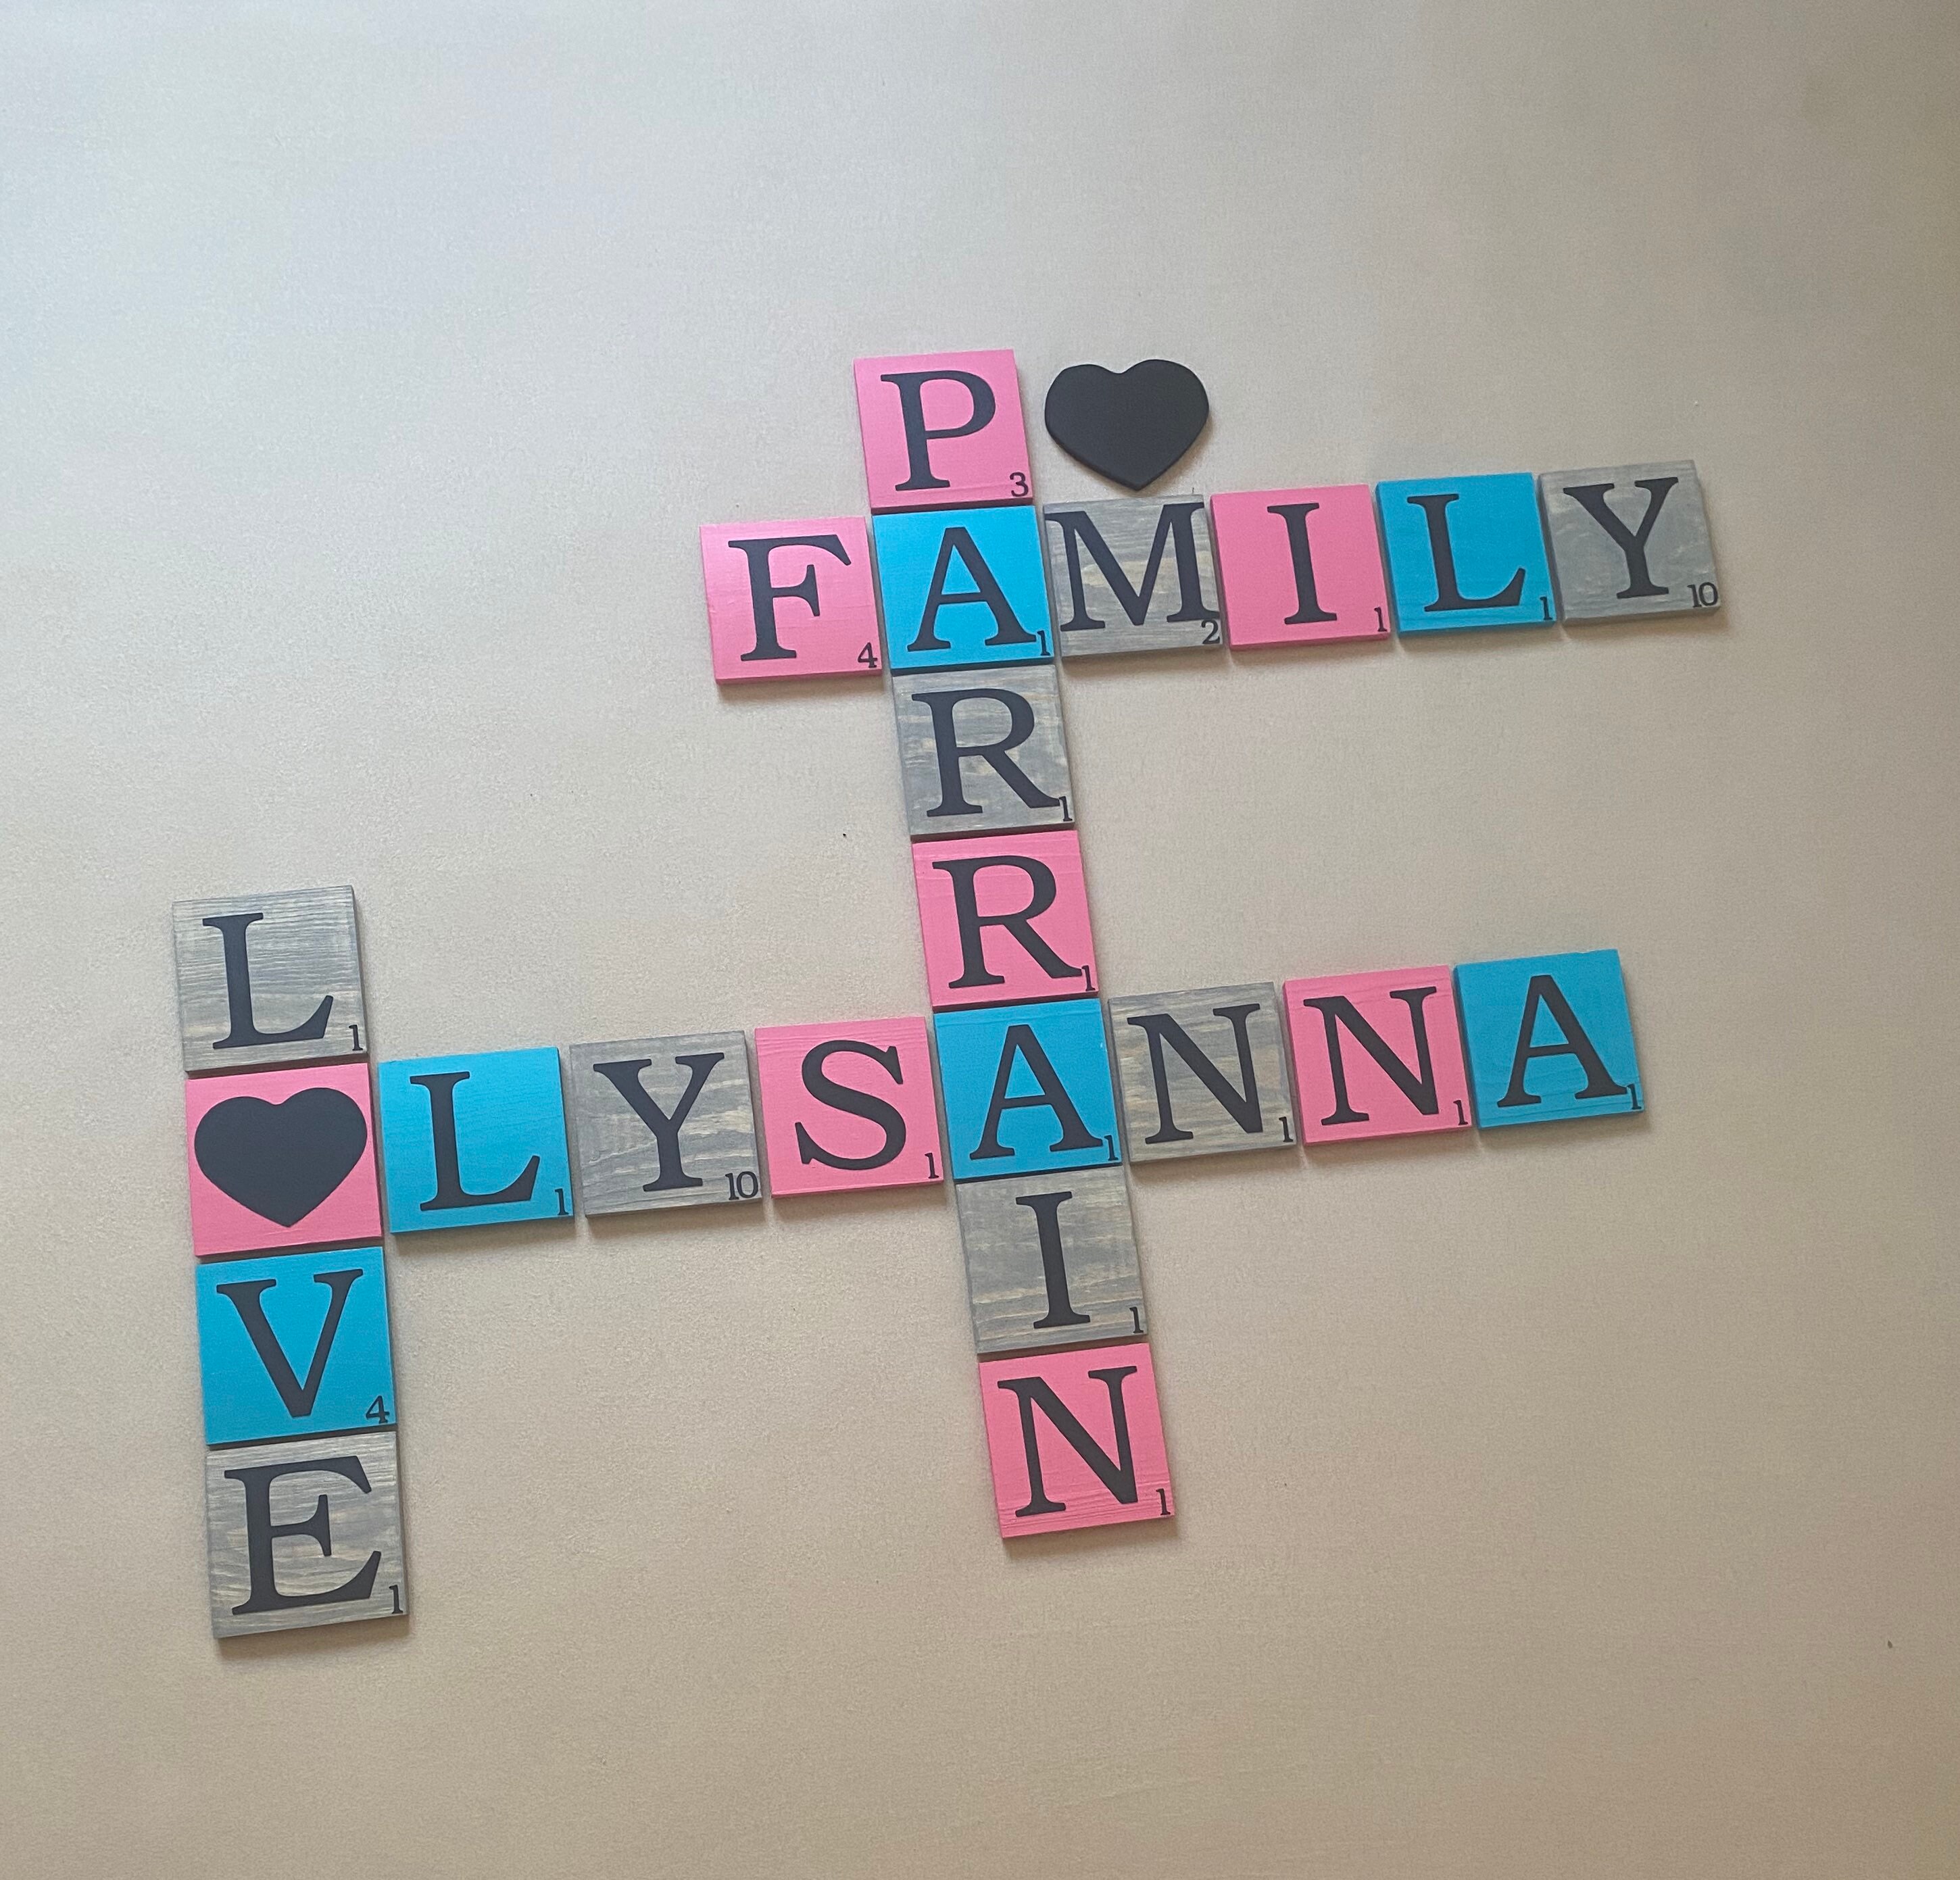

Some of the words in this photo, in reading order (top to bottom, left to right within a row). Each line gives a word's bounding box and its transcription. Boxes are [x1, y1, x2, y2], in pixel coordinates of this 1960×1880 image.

[1010, 472, 1029, 497] 3
[728, 476, 1679, 662] FAMILY
[1540, 596, 1553, 621] 1
[1688, 582, 1719, 608] 10
[1201, 619, 1221, 645] 2
[1374, 607, 1388, 632] 1
[858, 642, 878, 668] 4
[1037, 630, 1051, 655] 1
[1058, 795, 1073, 822] 1
[1081, 965, 1096, 991] 1
[348, 1024, 364, 1052] 1
[410, 974, 1629, 1212] LYSANNA
[1626, 1083, 1642, 1110] 1
[1453, 1099, 1469, 1126] 1
[1278, 1116, 1294, 1143] 1
[1104, 1135, 1119, 1162] 1
[924, 1152, 939, 1179] 1
[725, 1170, 759, 1201] 10
[554, 1188, 569, 1216] 1
[1129, 1306, 1144, 1334] 1
[366, 1395, 390, 1425] 4
[1156, 1488, 1171, 1516] 1
[389, 1584, 403, 1615] 1
